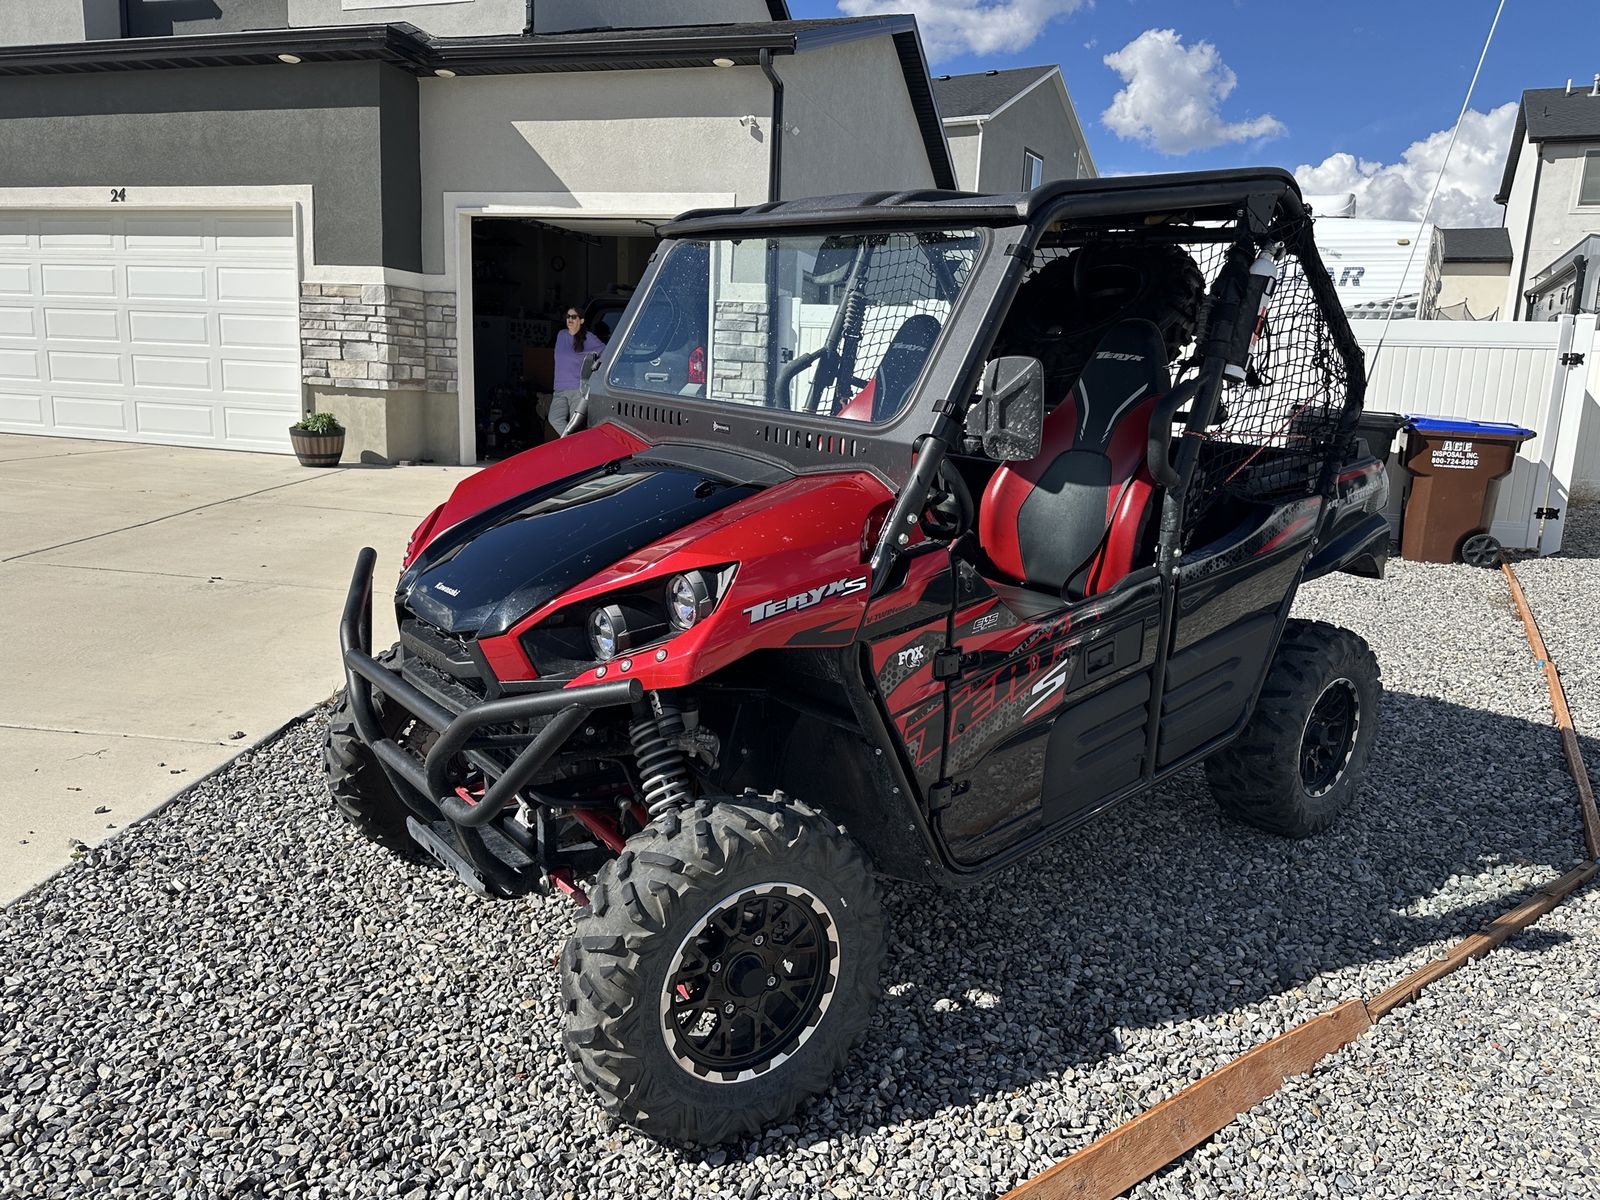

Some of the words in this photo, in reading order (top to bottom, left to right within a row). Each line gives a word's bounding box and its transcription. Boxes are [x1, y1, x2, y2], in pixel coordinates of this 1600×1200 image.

[110, 187, 127, 202] 24
[1442, 440, 1473, 452] ACE
[434, 581, 461, 597] Kawasaki
[897, 645, 925, 668] FOX
